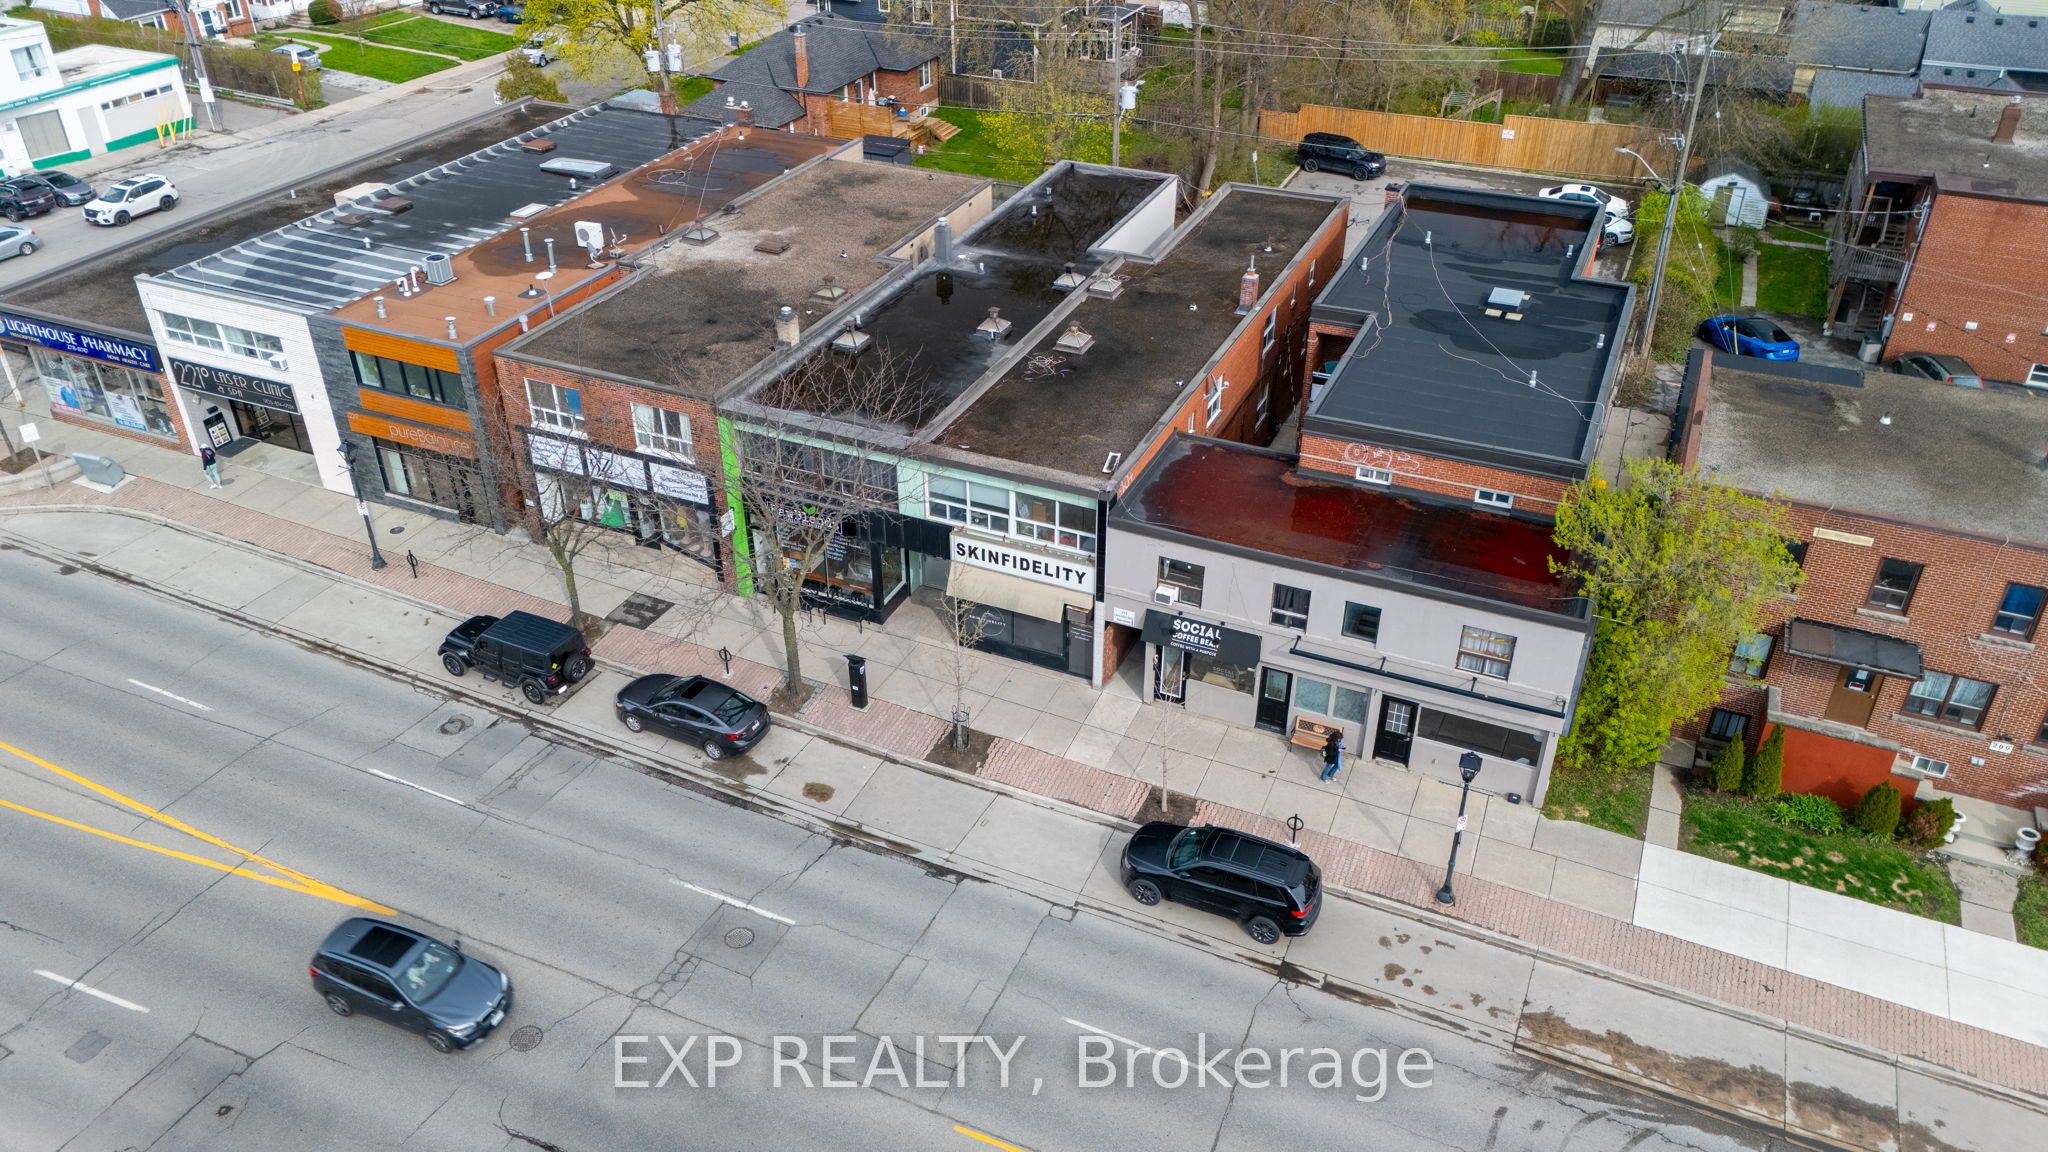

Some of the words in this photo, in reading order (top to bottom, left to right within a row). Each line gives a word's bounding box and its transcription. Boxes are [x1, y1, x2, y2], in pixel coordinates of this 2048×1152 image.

[4, 318, 78, 346] LIGHTHOUSE
[81, 335, 148, 362] PHARMACY
[212, 370, 247, 389] LASER
[252, 380, 292, 399] CLINIC
[227, 388, 243, 398] SPA
[956, 542, 1087, 585] SKINFIDELITY
[1172, 618, 1222, 641] SOCIAL
